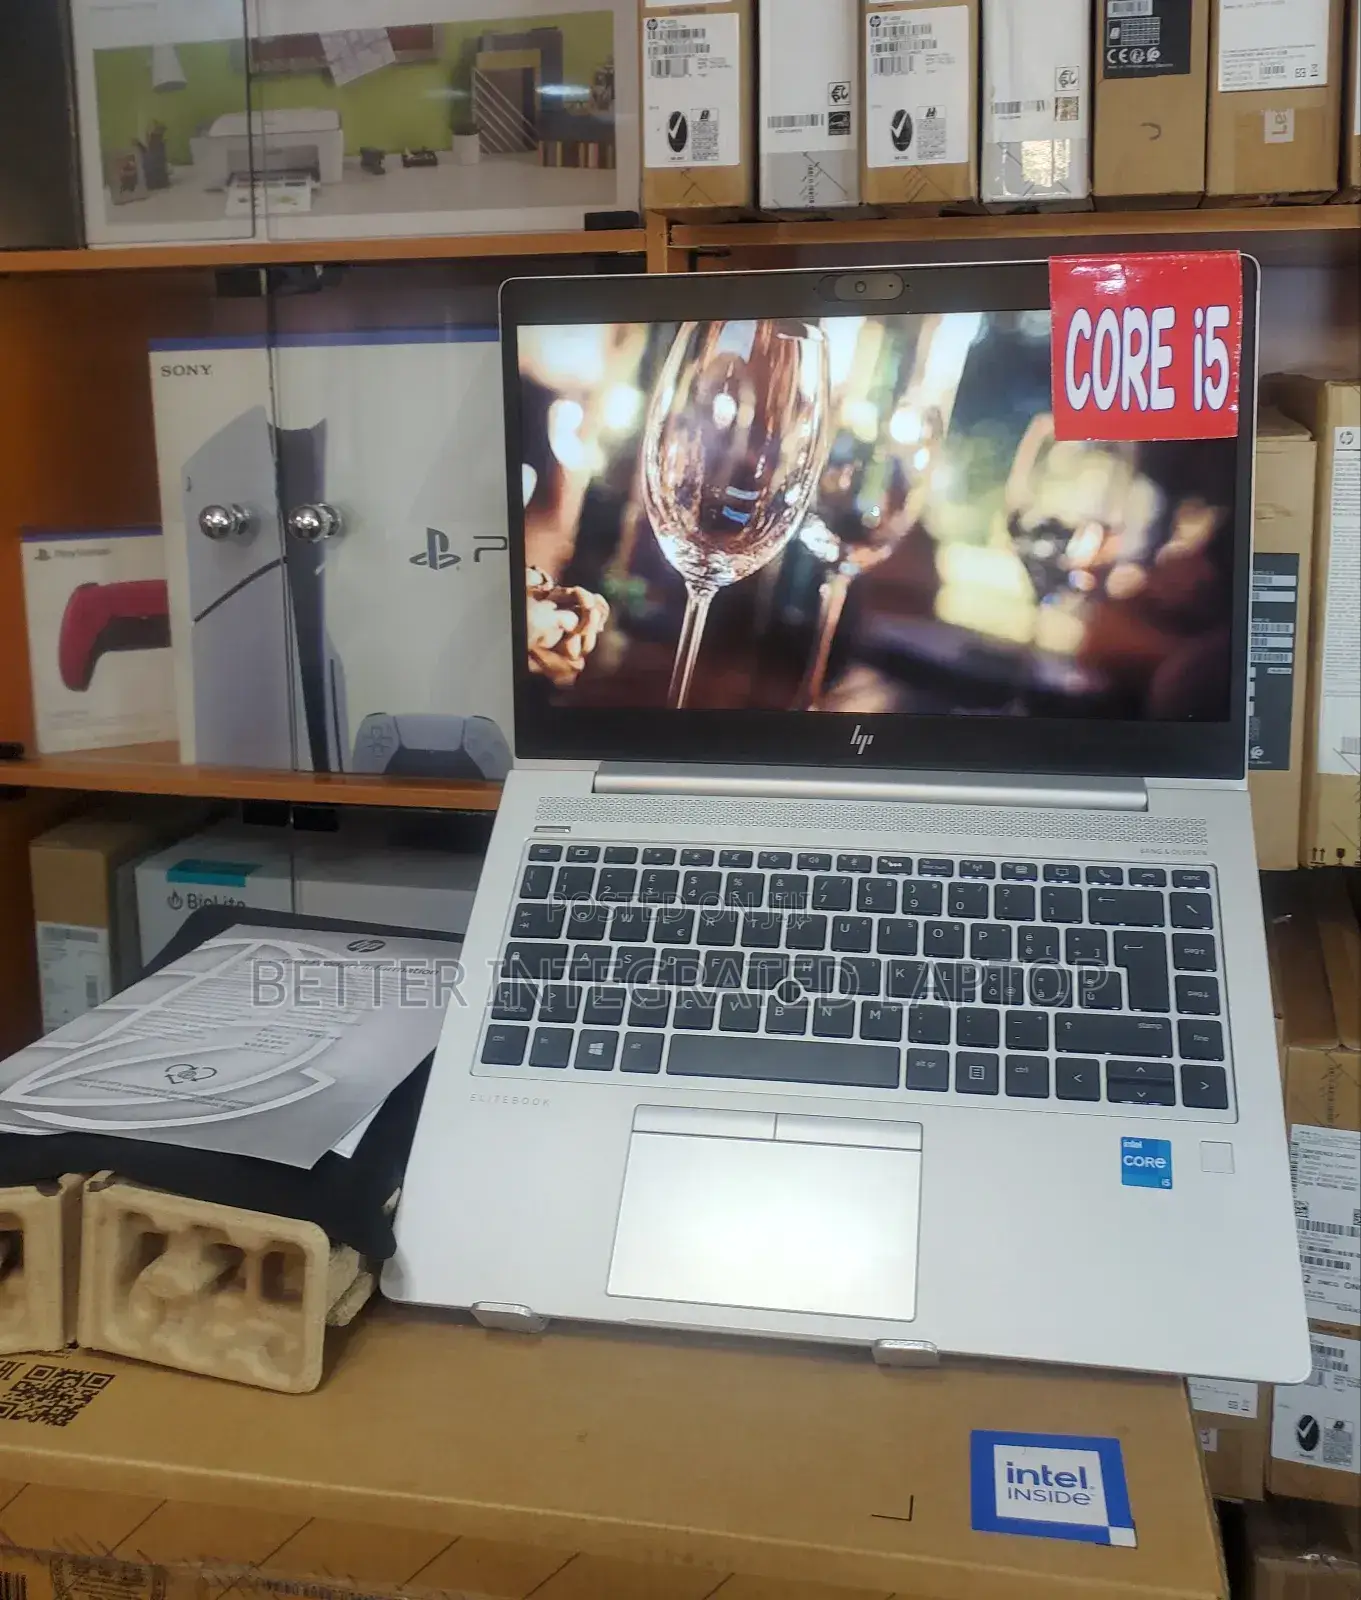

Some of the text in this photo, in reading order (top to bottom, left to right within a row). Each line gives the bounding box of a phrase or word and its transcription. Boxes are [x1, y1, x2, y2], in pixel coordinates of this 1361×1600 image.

[1065, 305, 1231, 411] CORE i5
[161, 364, 212, 378] SONY
[850, 724, 874, 755] hp
[840, 923, 850, 933] U
[979, 931, 988, 940] P
[775, 1006, 784, 1016] B
[870, 1010, 881, 1019] M
[469, 1093, 550, 1107] ELITEBOOK
[1006, 1461, 1089, 1490] intel
